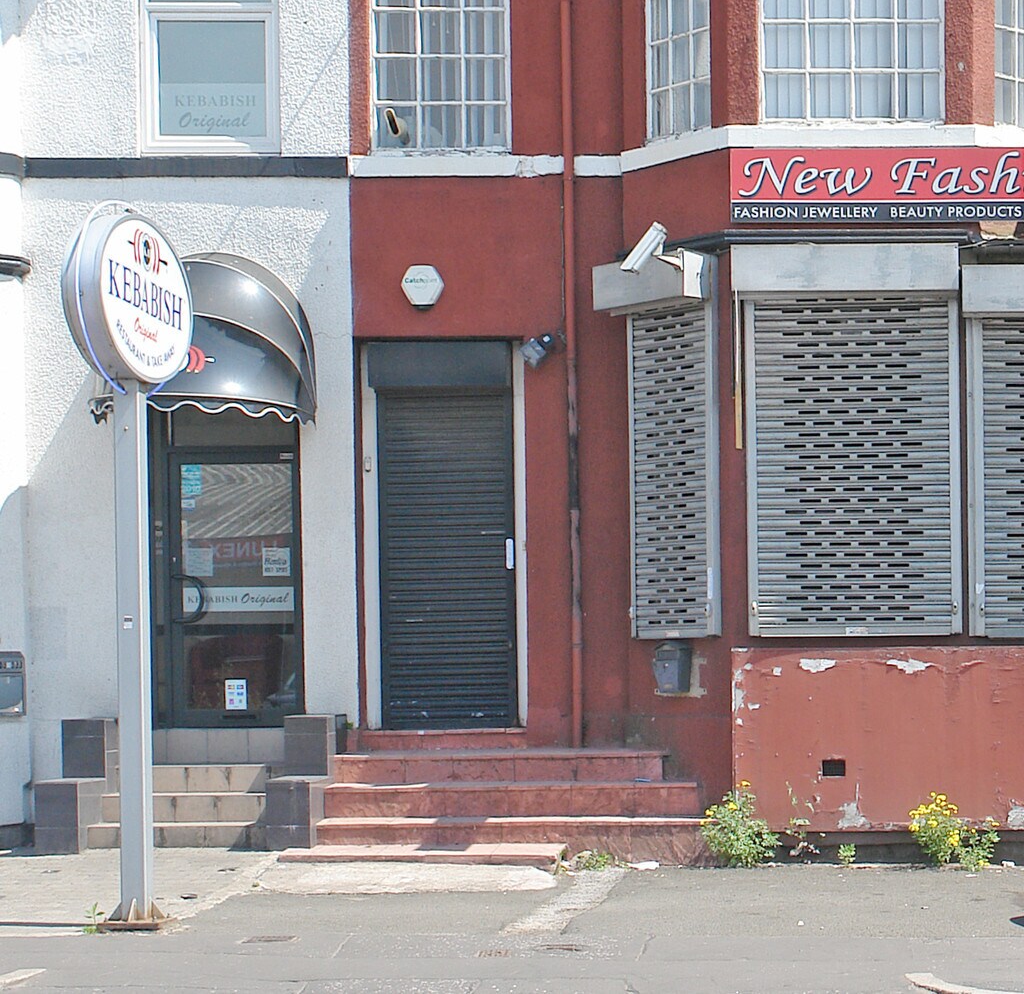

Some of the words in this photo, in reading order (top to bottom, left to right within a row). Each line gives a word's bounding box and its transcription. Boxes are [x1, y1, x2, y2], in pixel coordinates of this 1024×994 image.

[175, 95, 257, 107] KEBABISH
[179, 111, 251, 133] Original
[738, 156, 872, 197] New
[734, 206, 798, 218] FASHION
[802, 206, 878, 218] JEWELLERY
[890, 206, 948, 218] BEAUTY
[949, 206, 1022, 218] PRODUCTS
[108, 258, 183, 331] KEBABISH
[241, 591, 289, 606] Original
